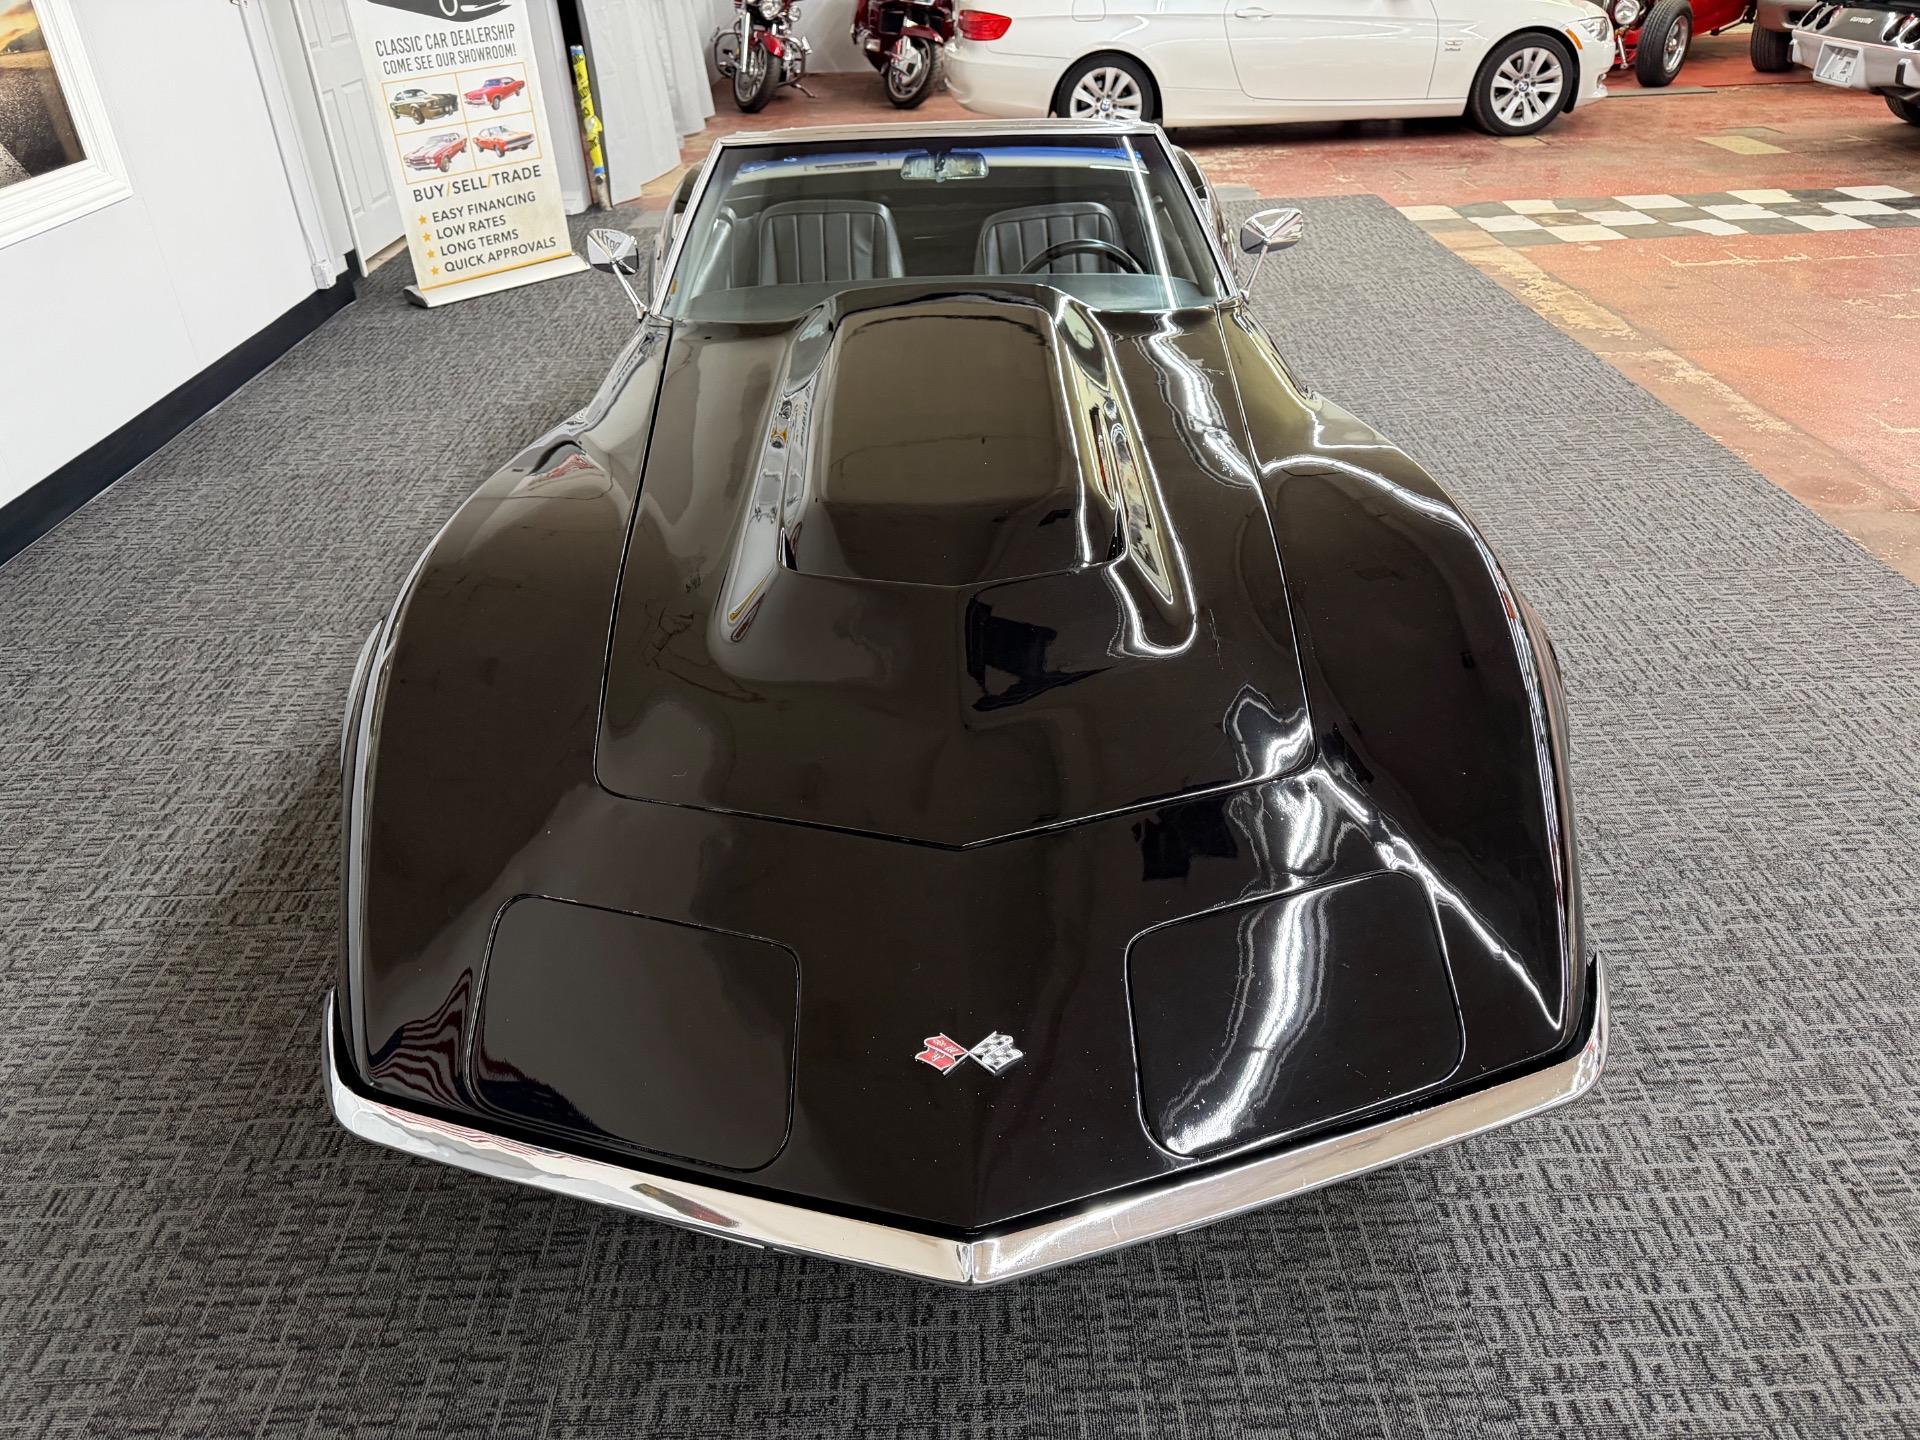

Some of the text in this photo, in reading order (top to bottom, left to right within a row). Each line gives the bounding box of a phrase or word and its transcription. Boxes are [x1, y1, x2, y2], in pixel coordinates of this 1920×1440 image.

[375, 23, 516, 57] CLASSIC CAR DEALERSHIP
[383, 43, 517, 75] COME SEE OUR SHOWROOM!
[432, 191, 536, 223] EASY FINANCING
[436, 214, 507, 240] LOW RATES
[440, 228, 519, 257] LONG TERMS
[444, 236, 556, 273] QUICK APPROVALS
